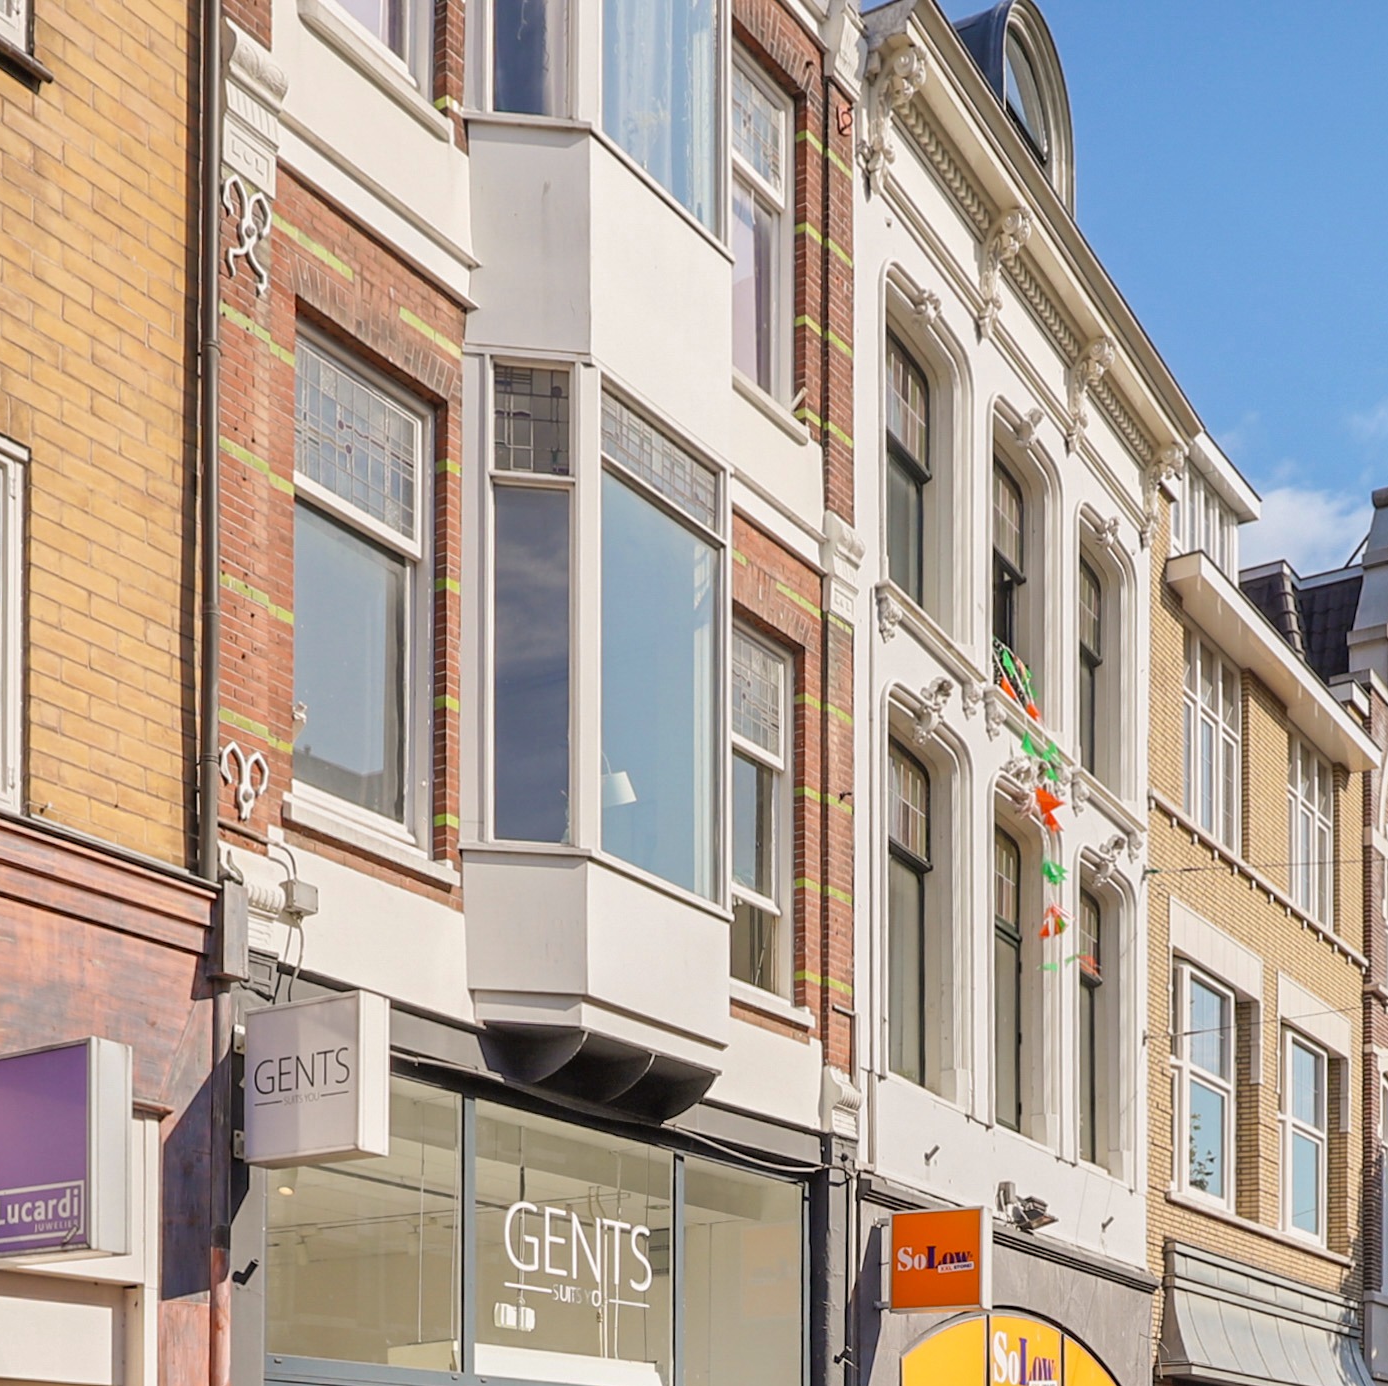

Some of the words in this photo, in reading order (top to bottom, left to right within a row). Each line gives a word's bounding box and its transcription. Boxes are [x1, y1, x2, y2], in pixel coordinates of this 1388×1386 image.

[254, 1047, 350, 1095] GENTS
[34, 1219, 79, 1233] JUWELIER
[504, 1200, 653, 1292] GENTS
[552, 1283, 582, 1304] SUITS
[585, 1289, 608, 1307] YO
